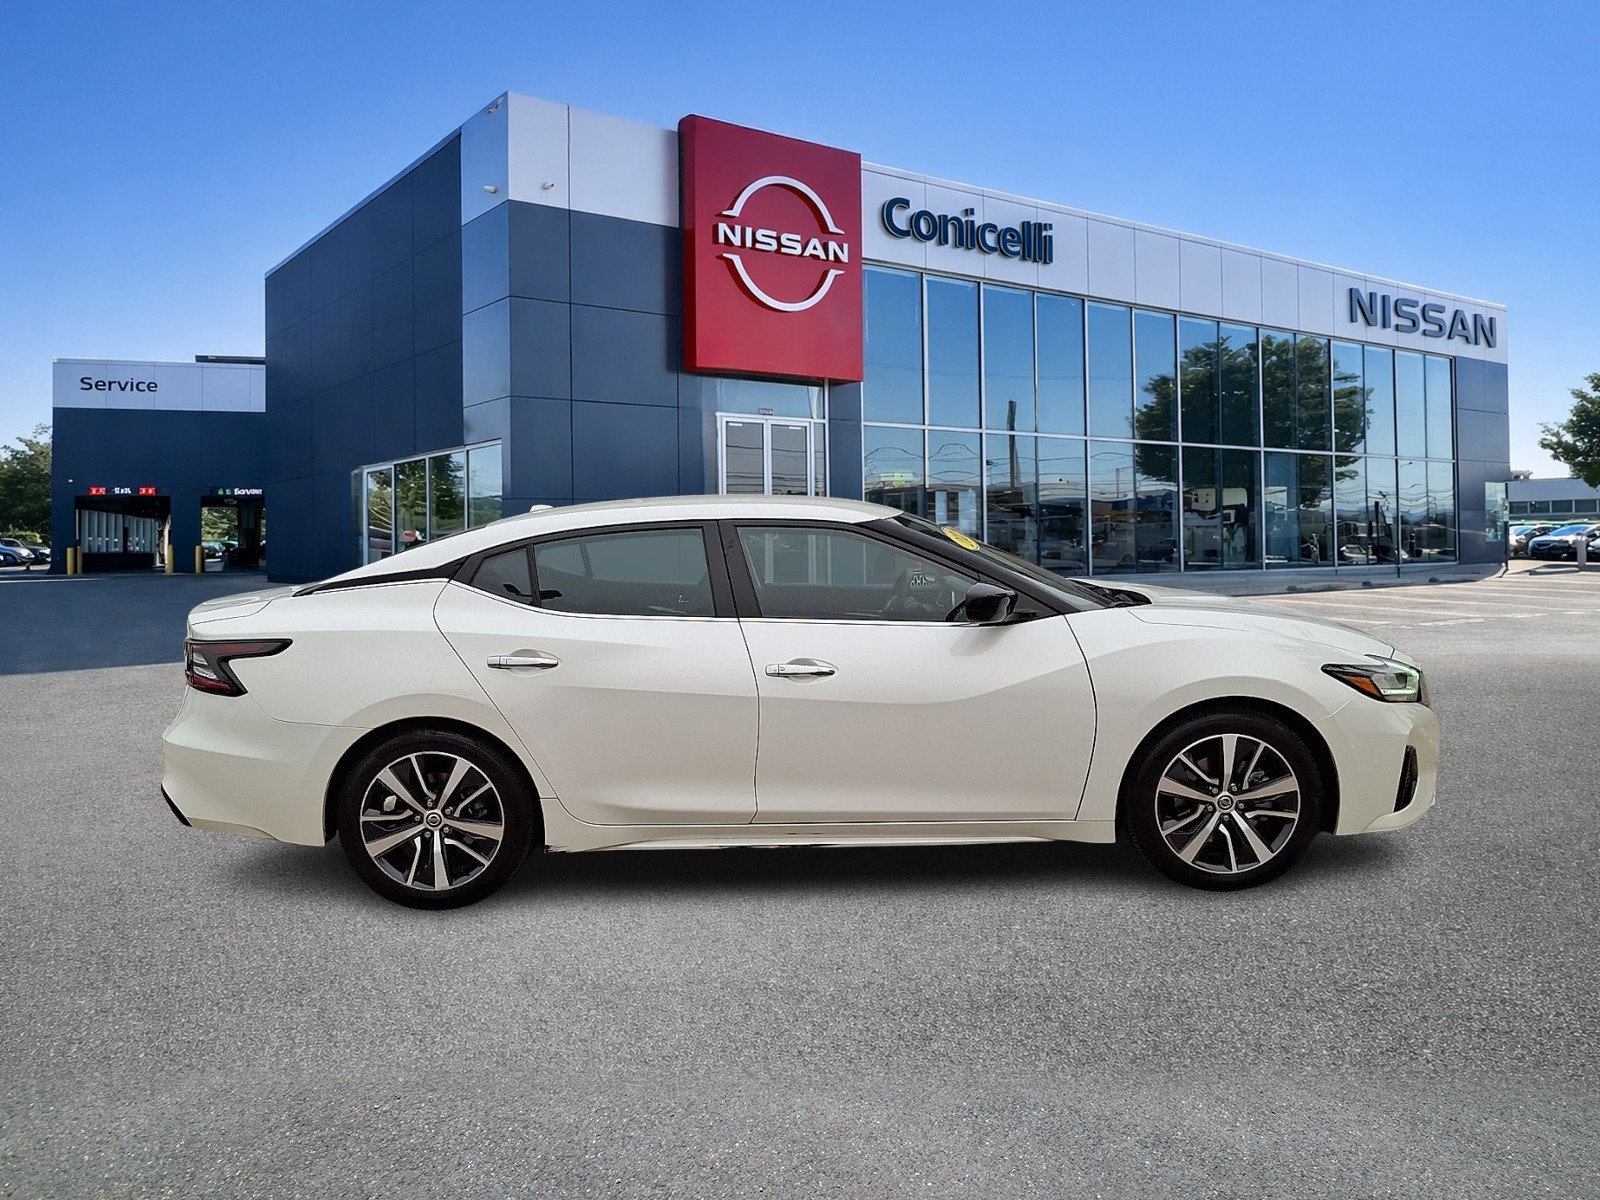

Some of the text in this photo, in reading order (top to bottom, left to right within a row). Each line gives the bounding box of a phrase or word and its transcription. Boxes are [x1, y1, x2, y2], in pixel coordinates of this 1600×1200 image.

[717, 222, 849, 263] NISSAN
[882, 197, 1053, 264] Conicelli
[1349, 287, 1497, 348] NISSAN
[80, 377, 158, 392] Service
